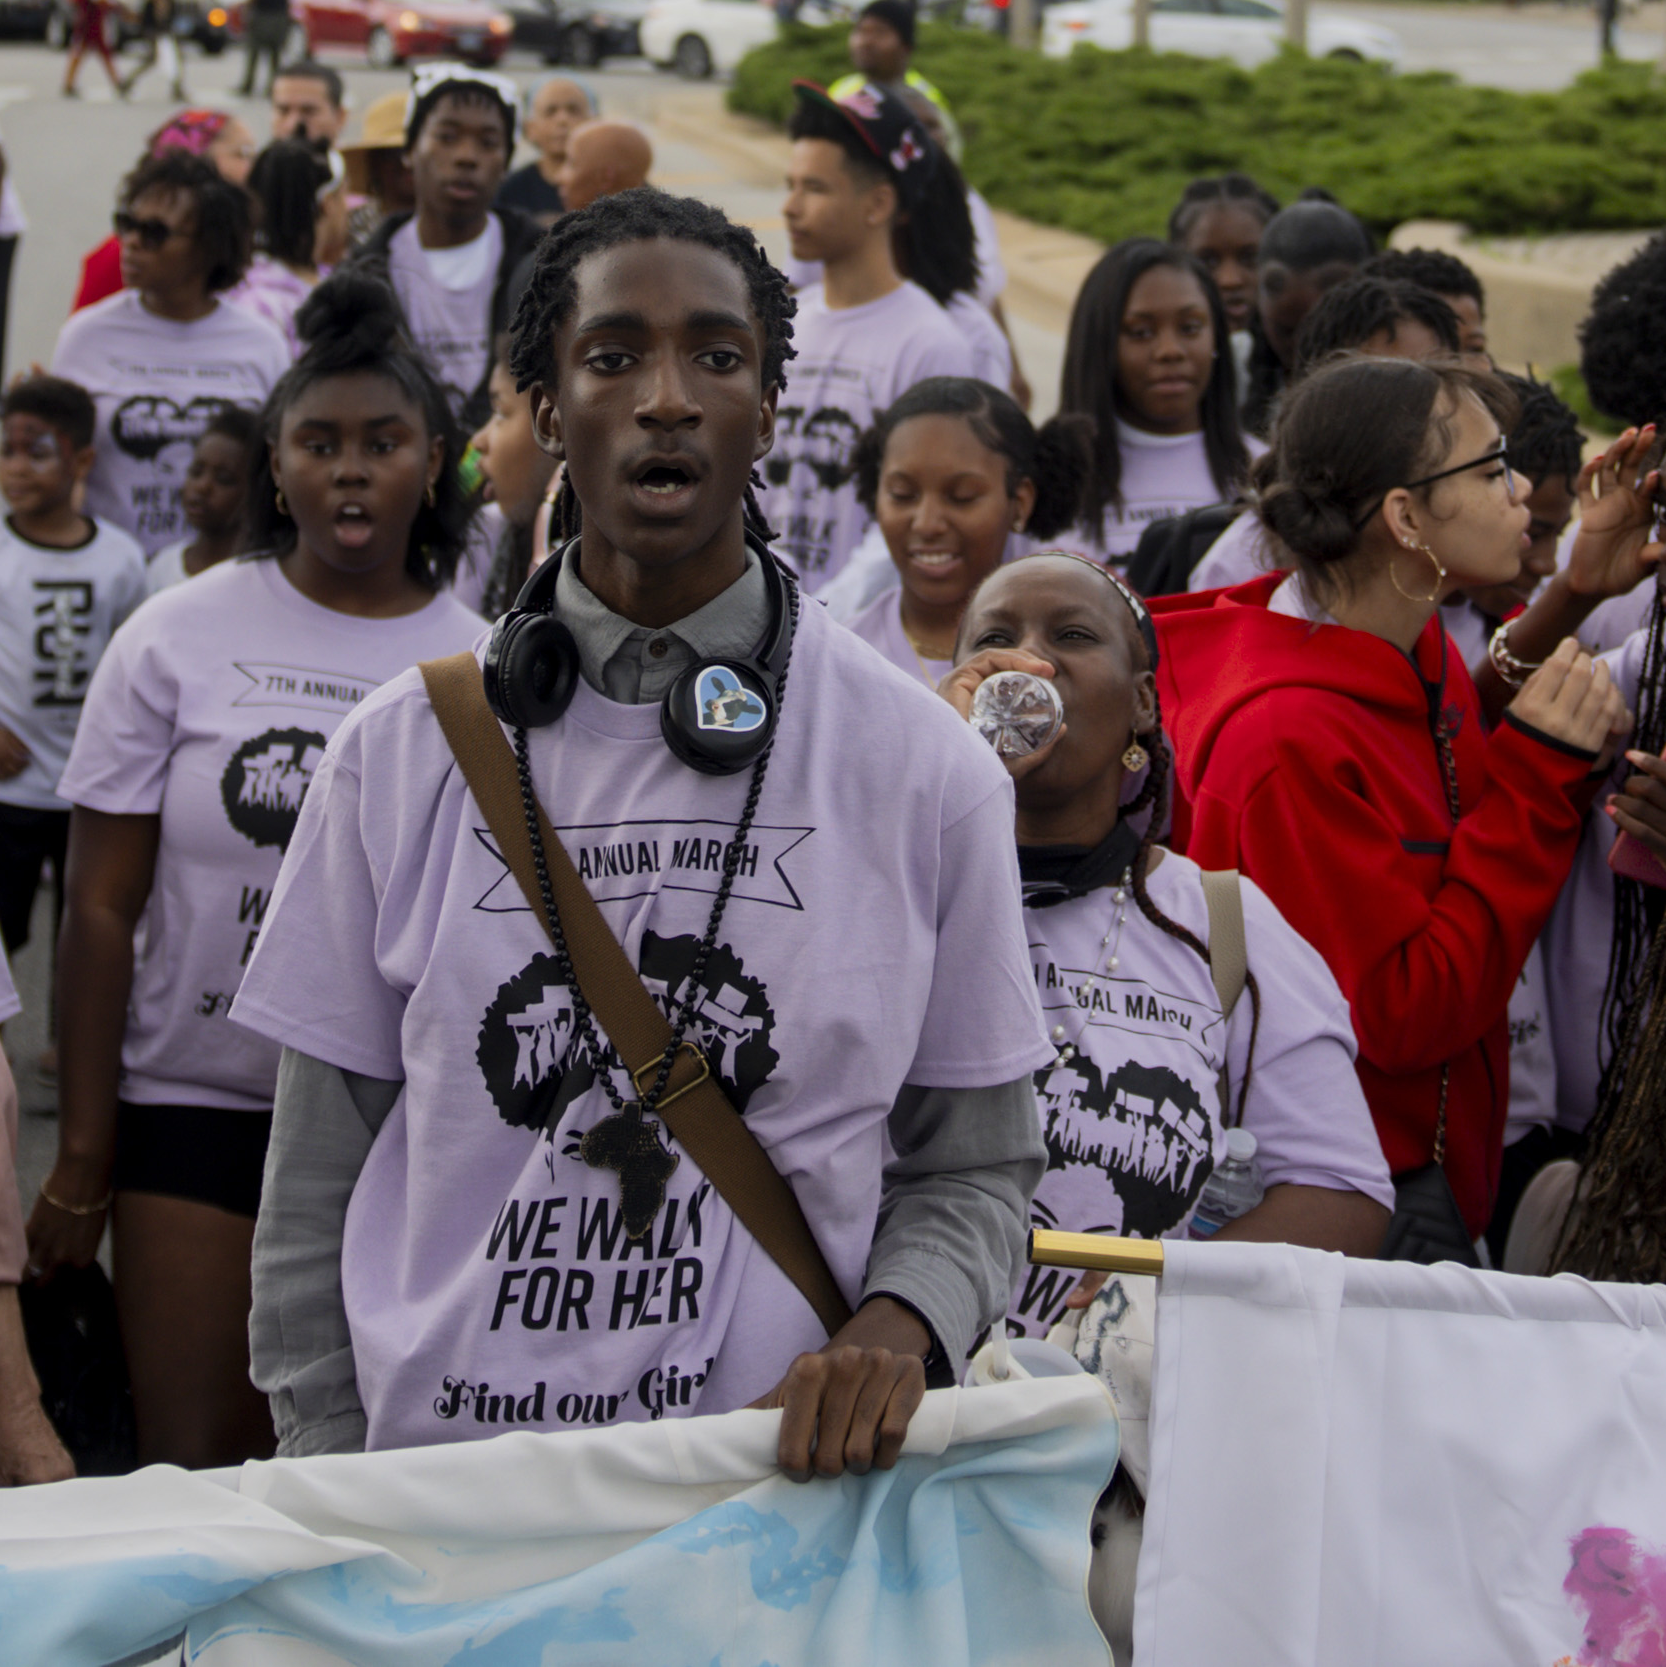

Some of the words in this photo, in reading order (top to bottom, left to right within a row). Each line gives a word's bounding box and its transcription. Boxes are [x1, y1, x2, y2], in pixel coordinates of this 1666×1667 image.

[266, 675, 296, 694] 7TH
[486, 1196, 568, 1262] WE
[489, 1265, 595, 1332] FOR
[608, 1256, 704, 1331] HER
[433, 1374, 547, 1424] Find
[556, 1389, 630, 1424] our
